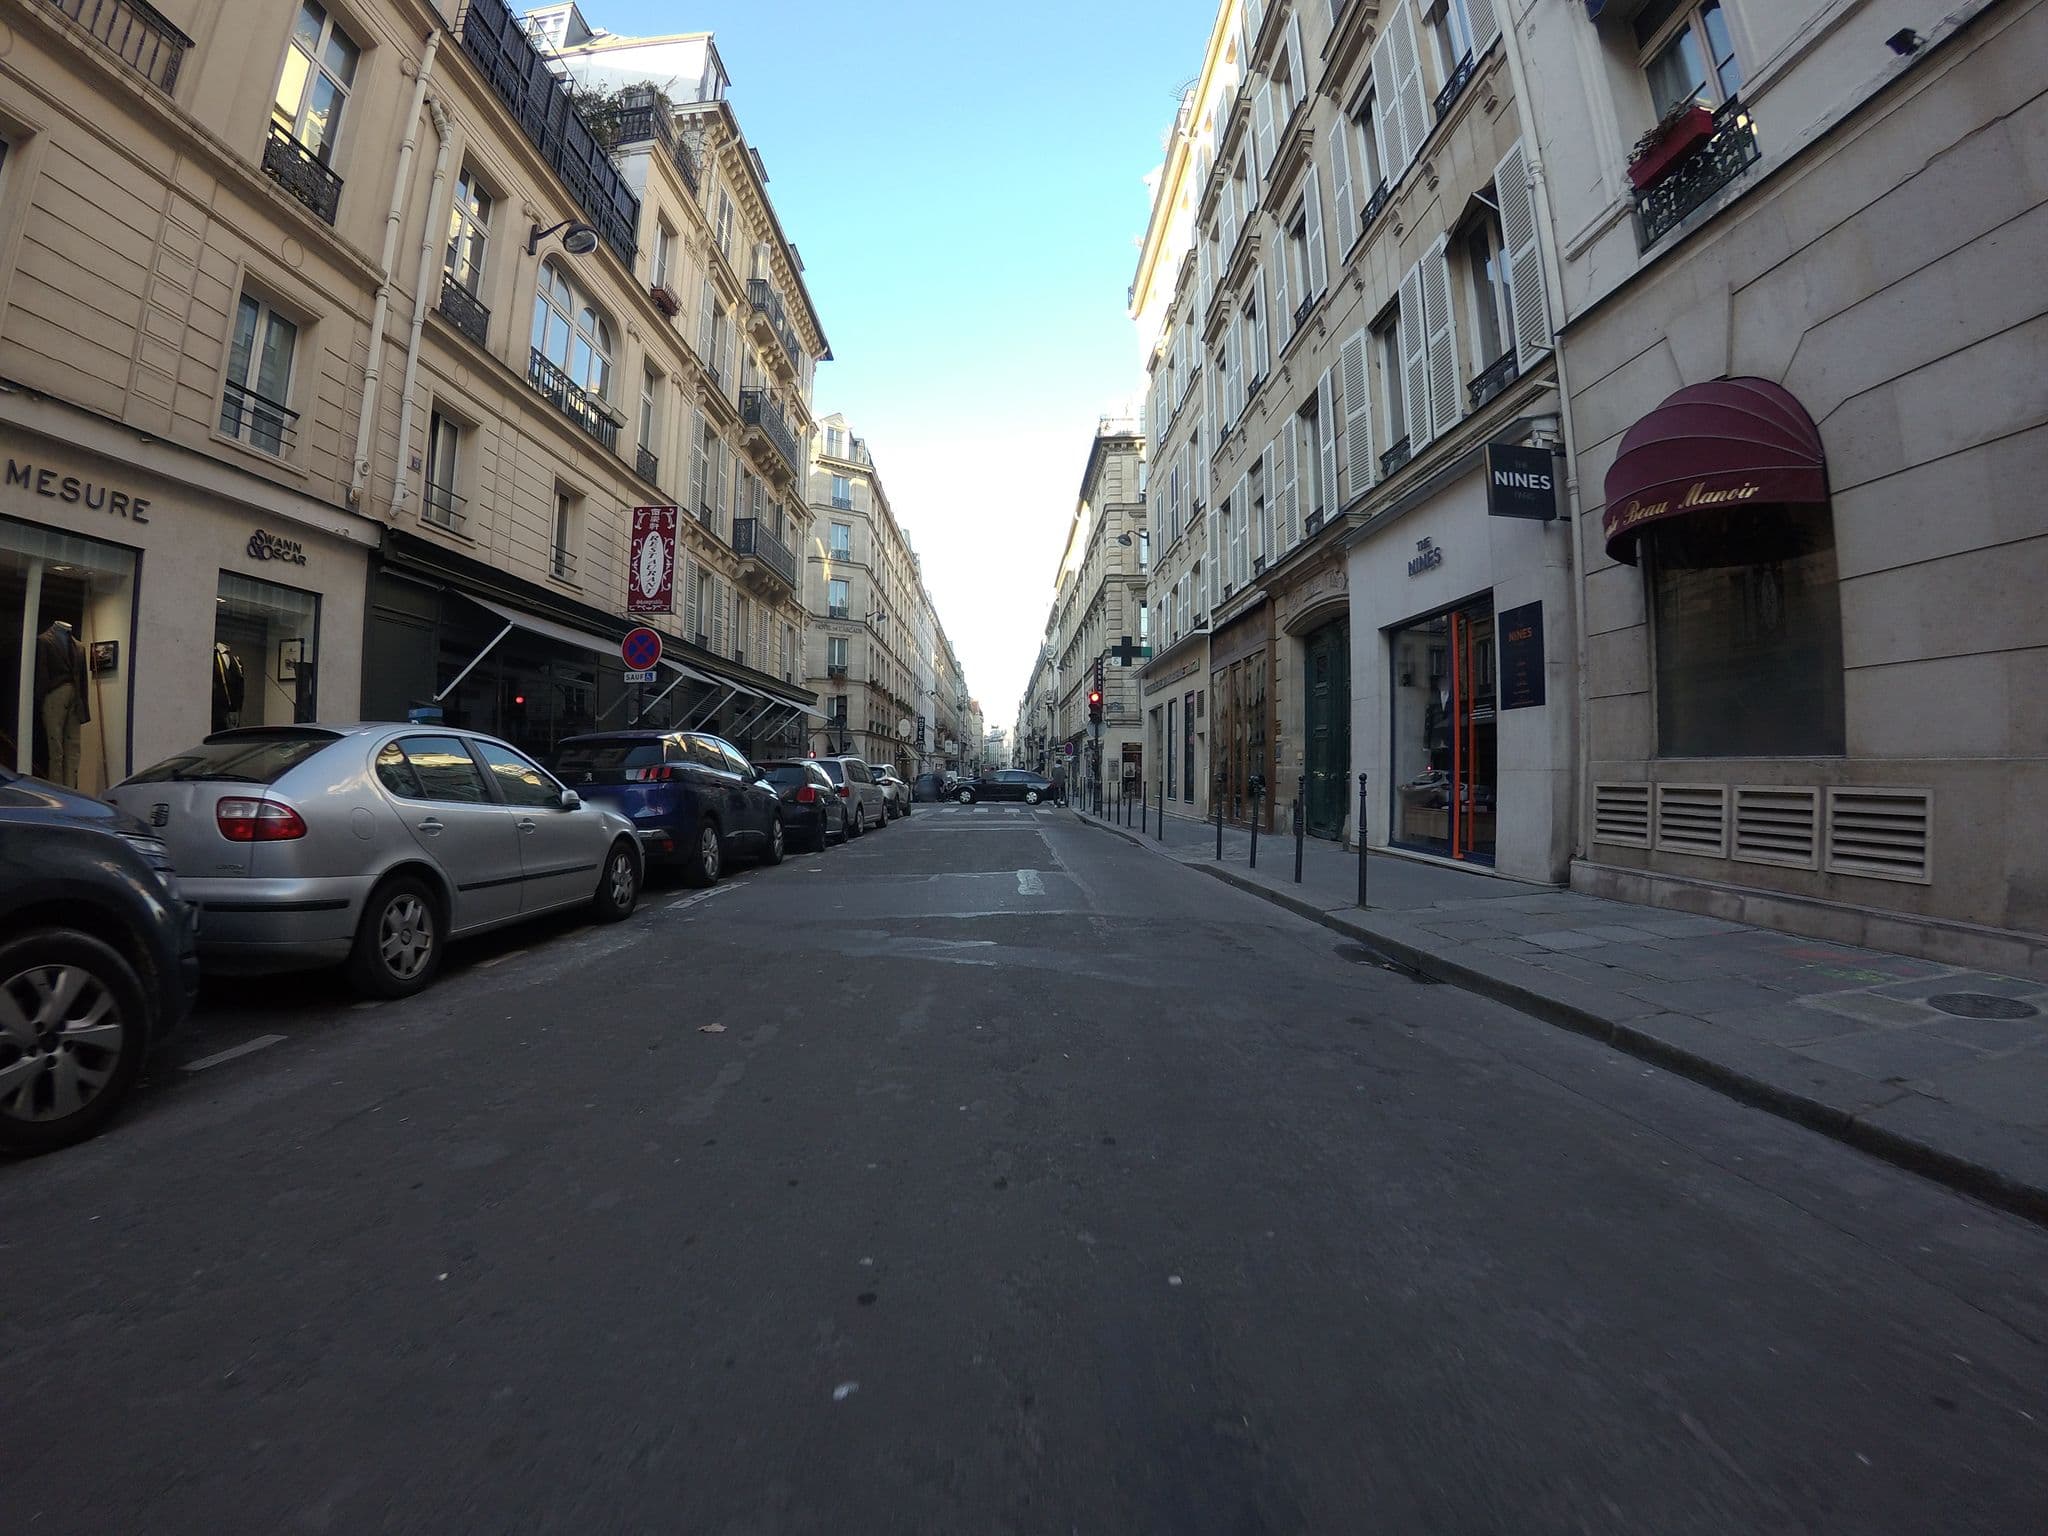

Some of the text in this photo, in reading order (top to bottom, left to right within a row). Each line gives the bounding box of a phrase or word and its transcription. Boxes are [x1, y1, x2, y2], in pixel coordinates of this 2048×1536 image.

[6, 458, 152, 524] MESURE
[1494, 470, 1551, 490] NINES
[1623, 500, 1669, 526] Beau
[1677, 482, 1760, 509] Manoir
[255, 529, 302, 553] SWANN
[1416, 536, 1432, 552] THE
[647, 535, 659, 594] RESTAURANT
[1408, 547, 1441, 577] NINES
[626, 673, 644, 681] SAUF
